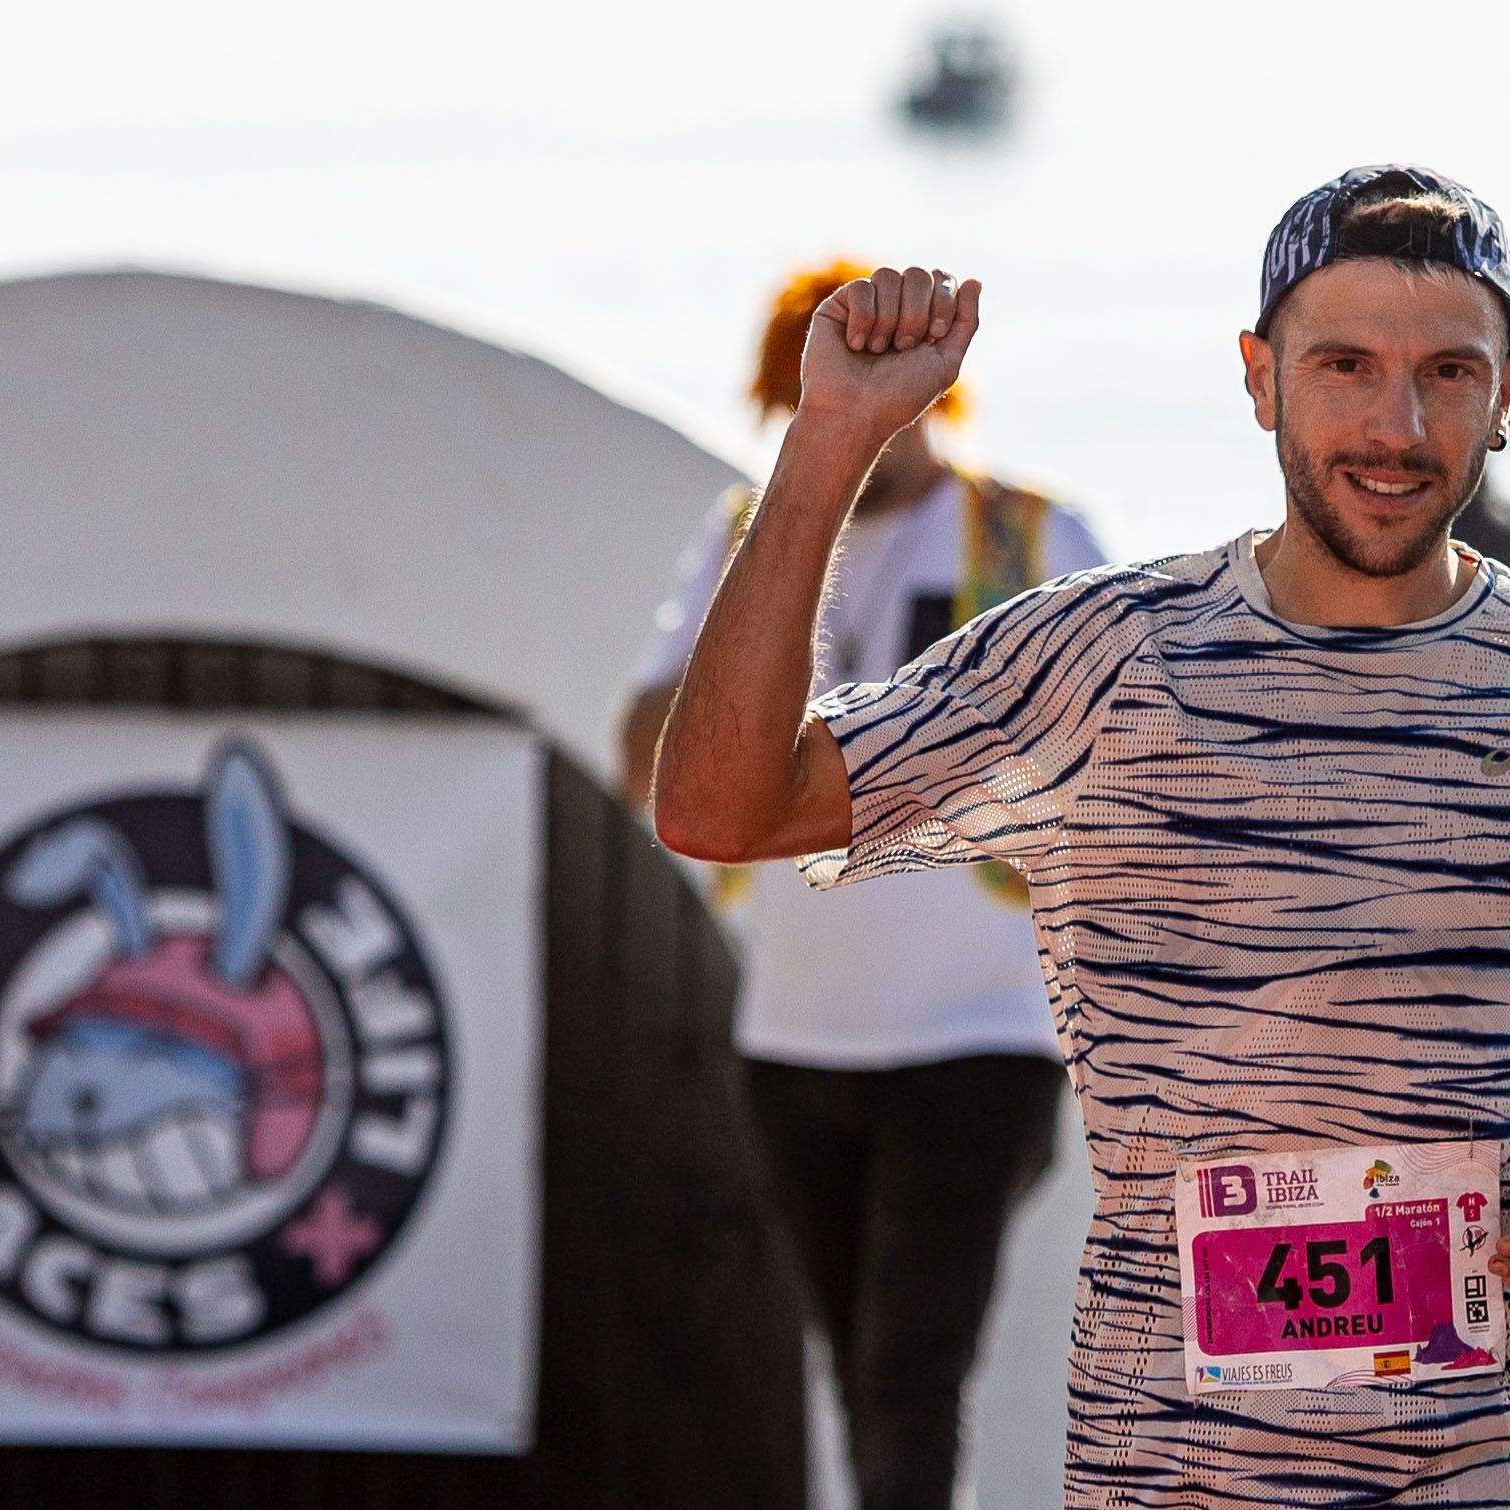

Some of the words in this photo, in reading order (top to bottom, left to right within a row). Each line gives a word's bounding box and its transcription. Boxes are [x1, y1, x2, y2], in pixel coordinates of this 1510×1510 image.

[1262, 1169, 1318, 1186] TRAIL
[1267, 1184, 1319, 1203] IBIZA
[1375, 1207, 1393, 1217] 1/2
[1395, 1202, 1440, 1215] Maratón
[1257, 1236, 1395, 1310] 451
[1281, 1312, 1384, 1339] ANDREU
[1222, 1365, 1250, 1381] VIAJES
[1253, 1365, 1263, 1380] ES
[1265, 1363, 1293, 1379] FREUS
